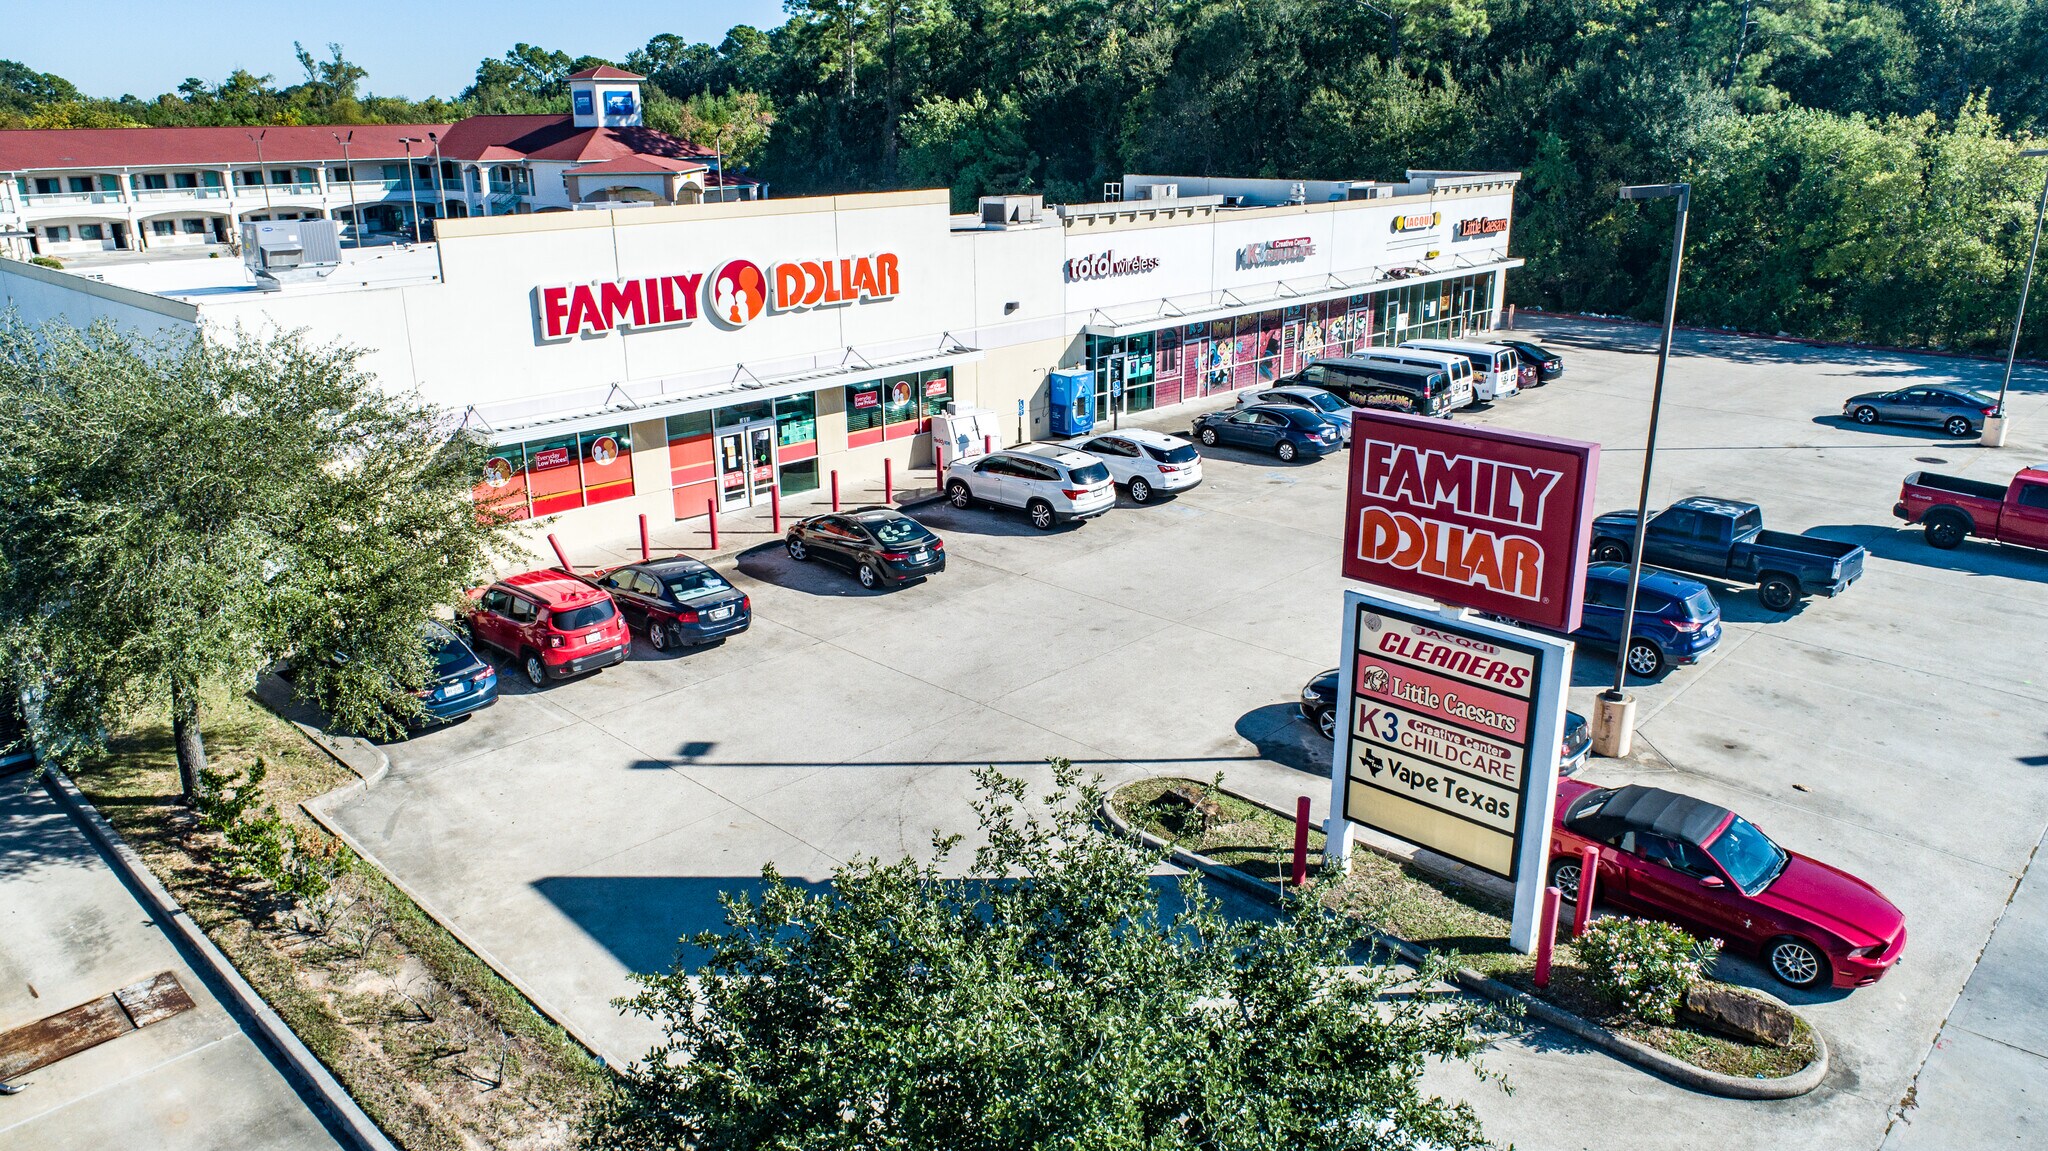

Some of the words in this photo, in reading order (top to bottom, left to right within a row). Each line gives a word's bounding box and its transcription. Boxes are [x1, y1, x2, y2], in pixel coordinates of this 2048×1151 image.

[1405, 216, 1432, 228] JACQUI
[1462, 219, 1481, 236] Little
[1482, 217, 1507, 234] Caesars
[1275, 240, 1294, 248] Creative
[1294, 238, 1309, 246] Center
[1115, 255, 1160, 273] wireless
[542, 272, 704, 338] FAMILY
[774, 251, 900, 309] DOLLAR
[1349, 391, 1367, 405] NOW
[537, 452, 560, 461] Everyday
[1362, 438, 1564, 531] FAMILY
[1357, 505, 1545, 603] DOLLAR
[1414, 626, 1495, 655] JACQUI
[1378, 631, 1531, 689] CLEANERS
[1391, 676, 1440, 709] Little
[1443, 693, 1517, 734] Caesars
[1359, 703, 1399, 743] K3
[1401, 731, 1516, 781] CHILDCARE
[1413, 720, 1462, 744] Creative
[1463, 734, 1505, 758] Center
[1388, 757, 1439, 793] Vape
[1442, 776, 1510, 819] Texas
